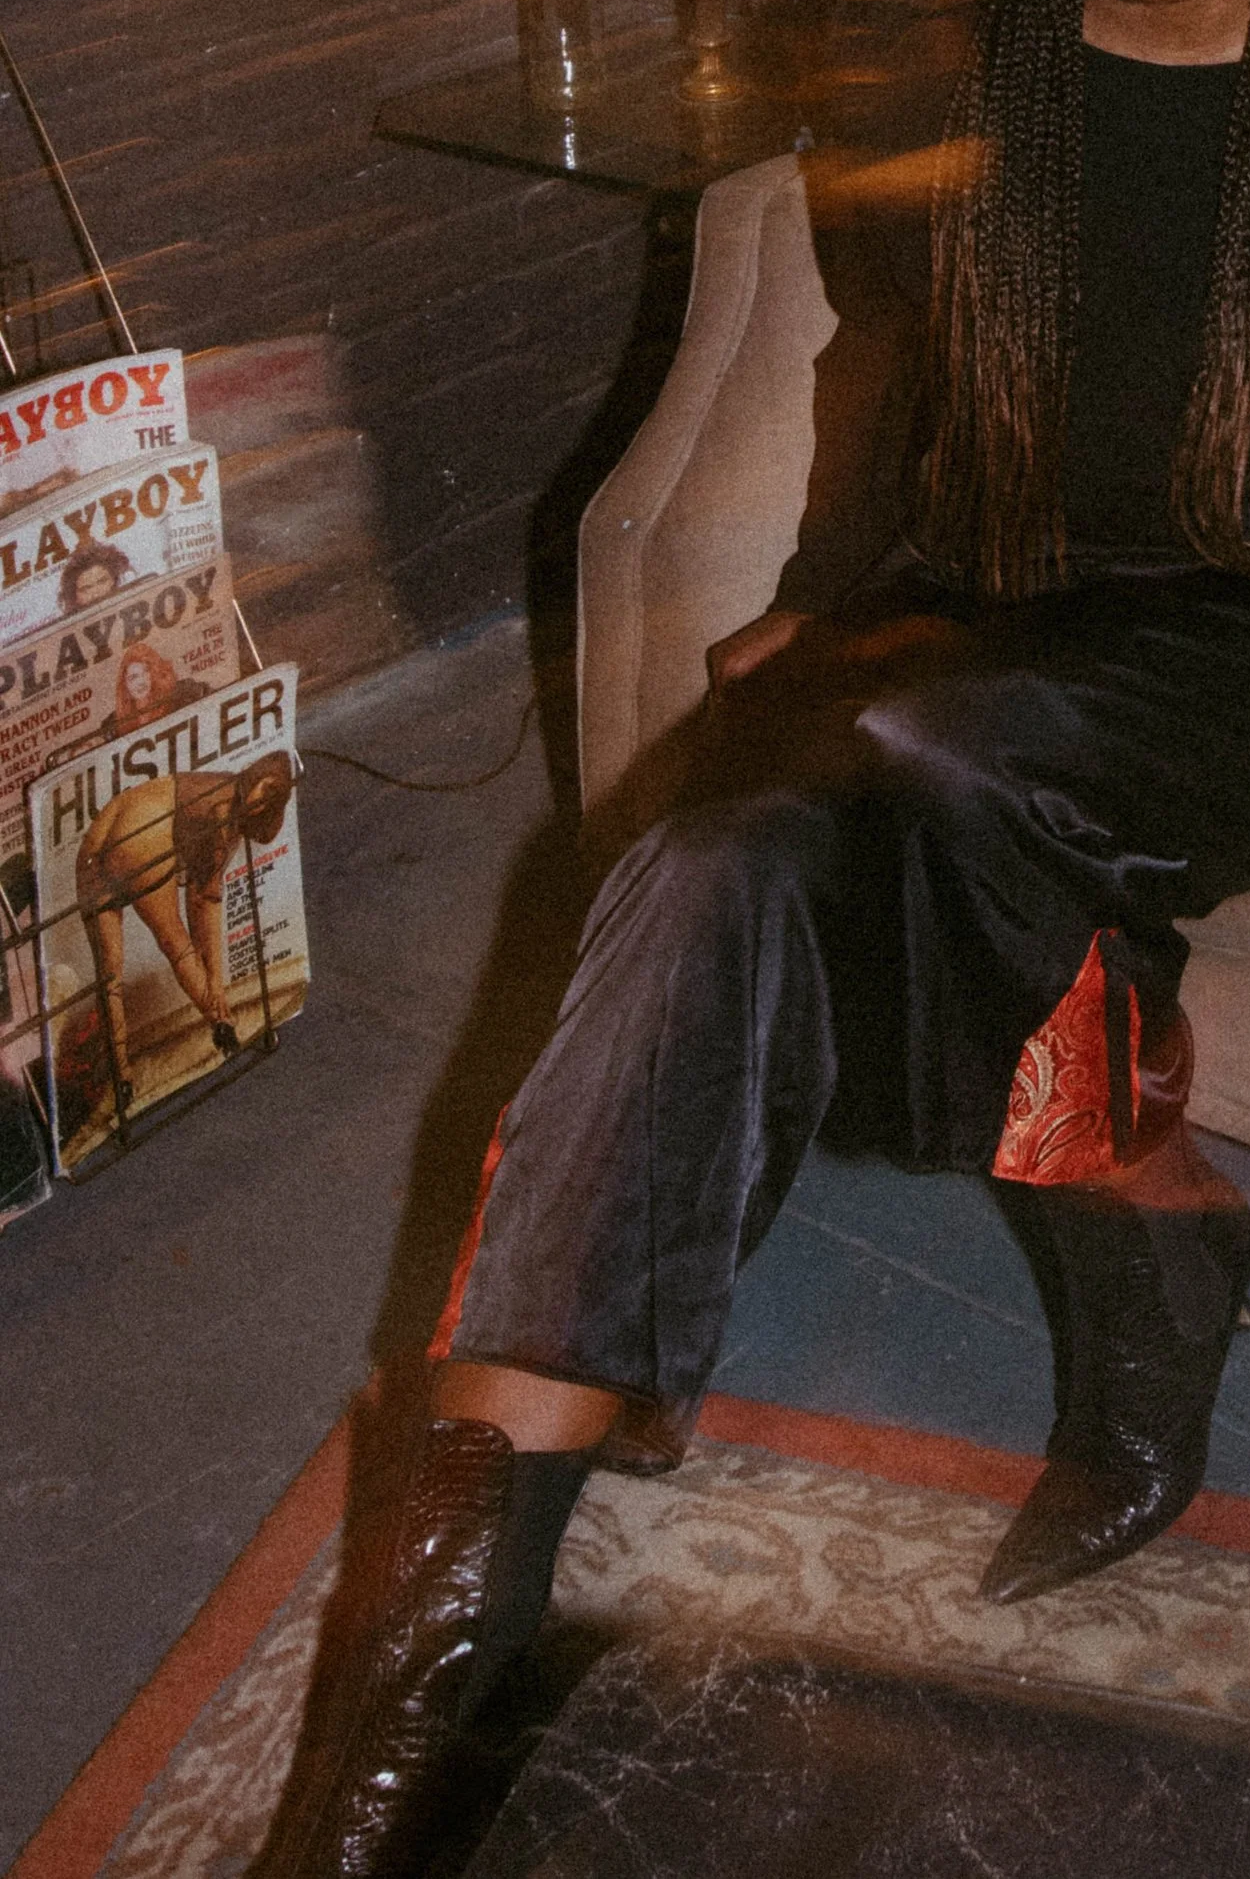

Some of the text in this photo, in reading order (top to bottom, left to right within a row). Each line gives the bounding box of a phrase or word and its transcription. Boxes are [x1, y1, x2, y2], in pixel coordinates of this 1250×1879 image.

[134, 424, 177, 450] THE
[0, 458, 208, 590] LAYBOY
[64, 687, 92, 712] AND
[43, 706, 91, 740] TWEED
[53, 678, 284, 846] HUSTLER
